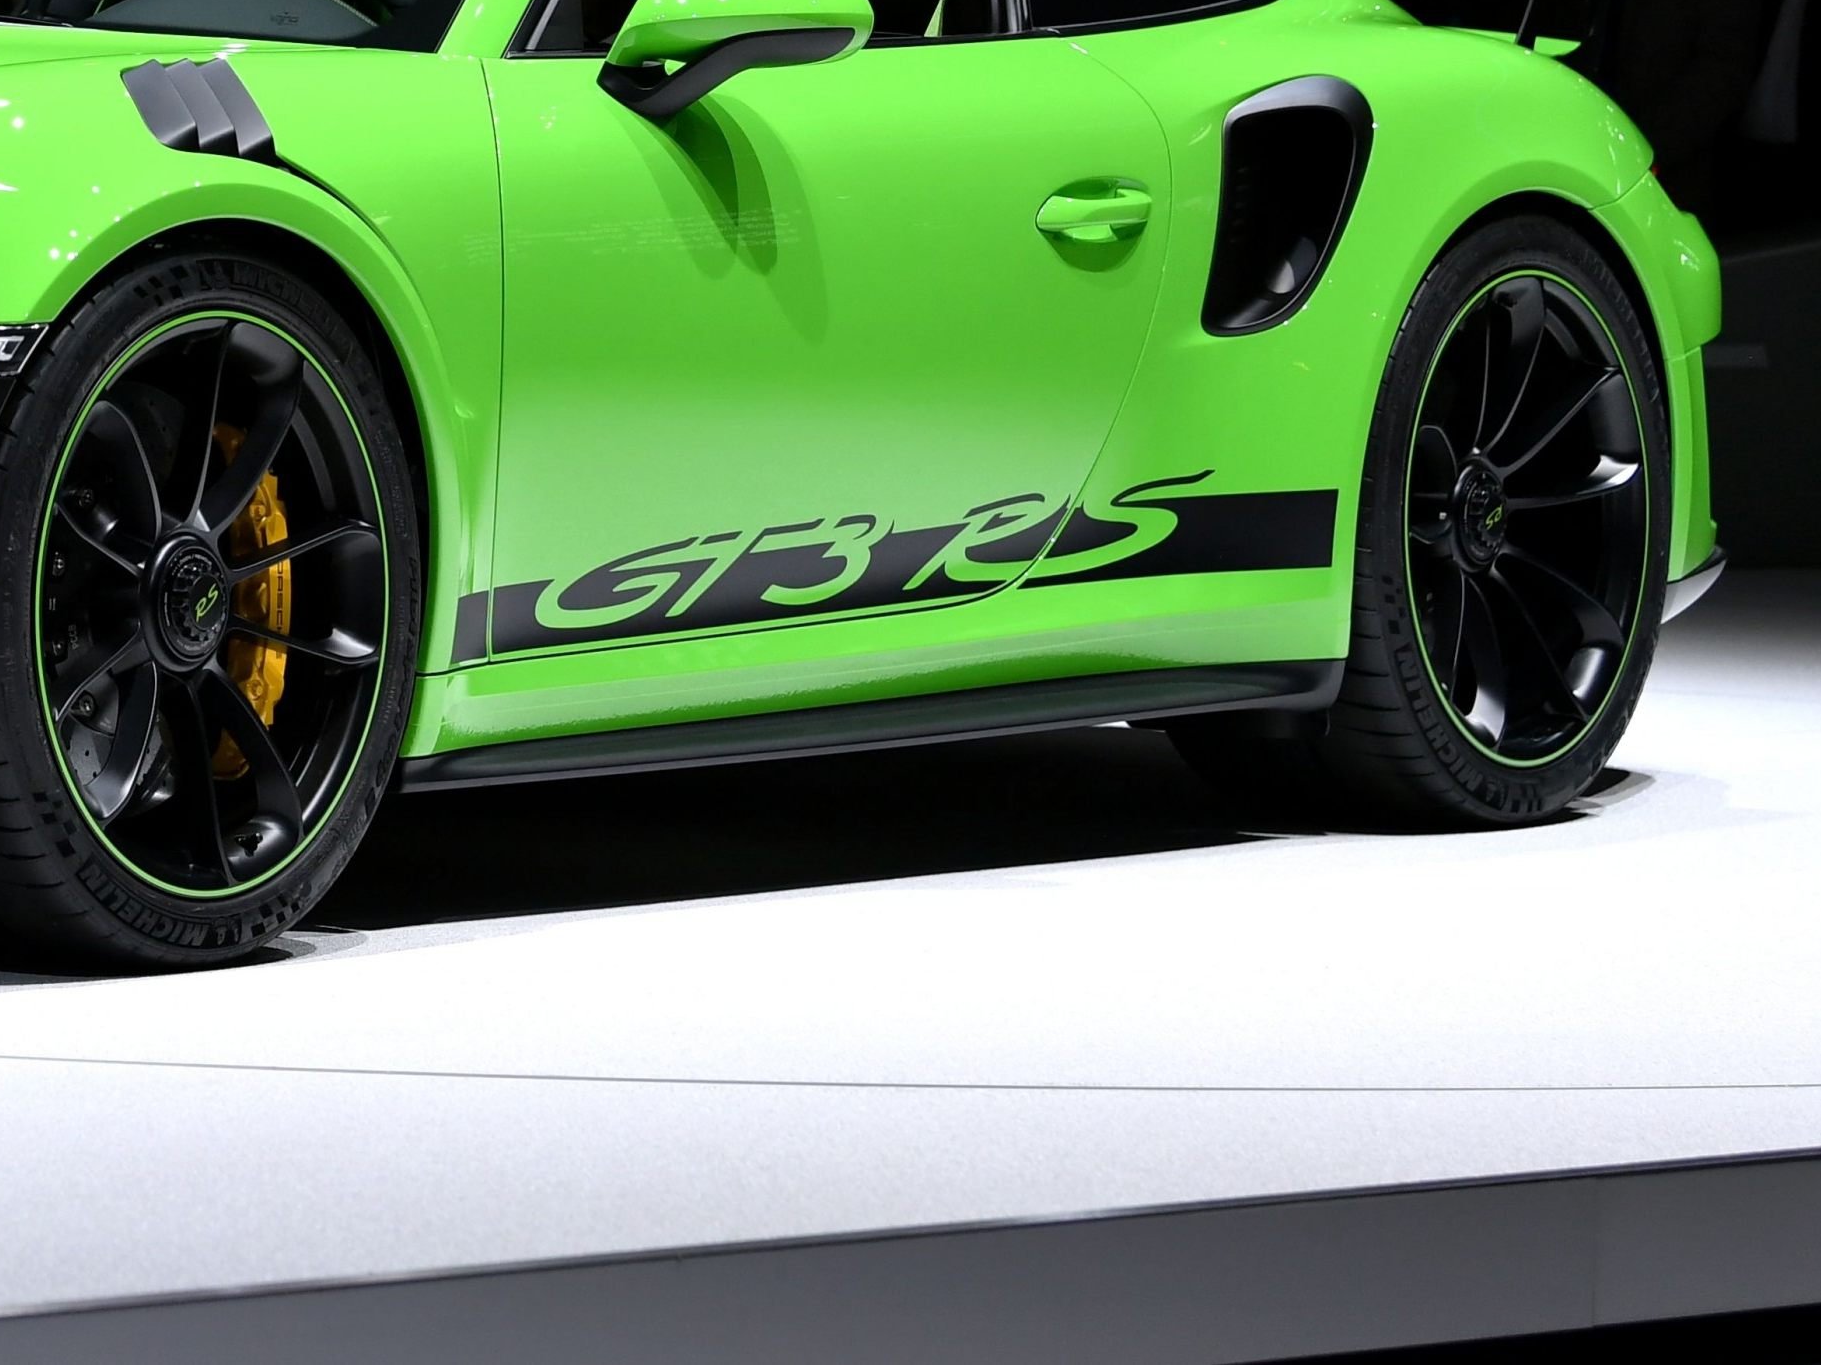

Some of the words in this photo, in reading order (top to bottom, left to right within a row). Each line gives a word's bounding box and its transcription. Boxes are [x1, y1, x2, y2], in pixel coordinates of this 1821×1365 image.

[901, 469, 1215, 591] RS
[194, 582, 219, 623] RS
[1394, 650, 1485, 793] MICHELIN
[79, 863, 212, 947] MICHELIN
